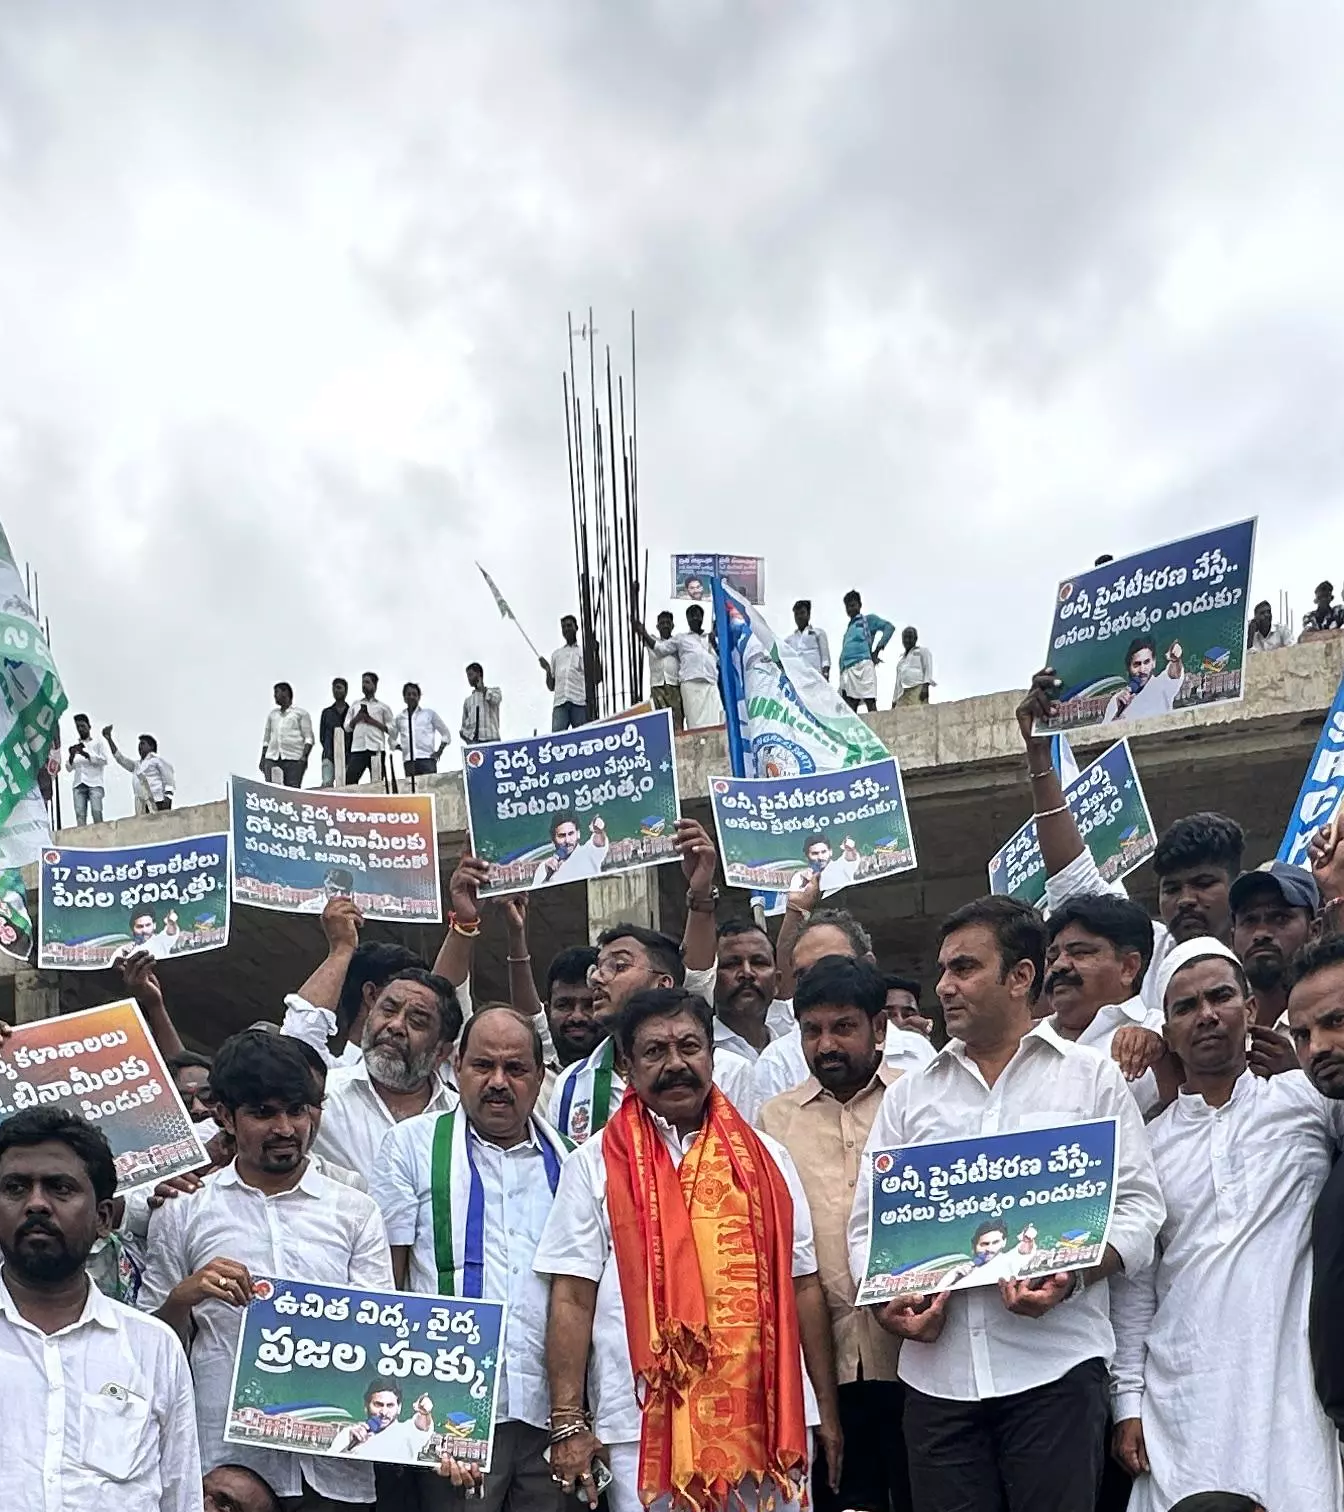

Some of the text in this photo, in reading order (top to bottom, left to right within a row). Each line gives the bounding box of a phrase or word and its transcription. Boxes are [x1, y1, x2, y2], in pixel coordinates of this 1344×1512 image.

[1094, 563, 1188, 619] ప్రైవేటీకరణ
[1054, 586, 1243, 650] అసలు ప్రభుత్వం ఎందుకు?
[493, 723, 646, 779] వైద్య కళాశాలల్ని
[496, 772, 550, 798] వ్యాపార
[552, 765, 602, 785] శాలలు
[497, 776, 655, 820] కూటమి ప్రభుత్వం
[760, 786, 846, 820] ప్రైవేటీకరణ
[244, 791, 420, 829] ప్రభుత్వ వైద్య కళాశాలలు
[725, 816, 770, 832] అసలు
[771, 815, 830, 836] ప్రభుత్వం
[324, 824, 427, 852] బినామీలకు
[367, 852, 429, 870] పిండుకో
[51, 851, 221, 884] 17 మెడికల్ కాలేజీలు
[52, 873, 218, 909] పేదల భవిష్యత్తు
[14, 1025, 129, 1072] కళాశాలలు
[12, 1054, 153, 1108] బినామీలకు
[83, 1077, 164, 1125] పిండుకో
[928, 1153, 1043, 1201] ప్రైవేటీకరణ
[880, 1180, 1108, 1227] అసలు ప్రభుత్వం ఎందుకు?
[273, 1288, 482, 1345] ఉచిత విద్య, వైద్య
[256, 1324, 488, 1398] ప్రజల హక్కు
